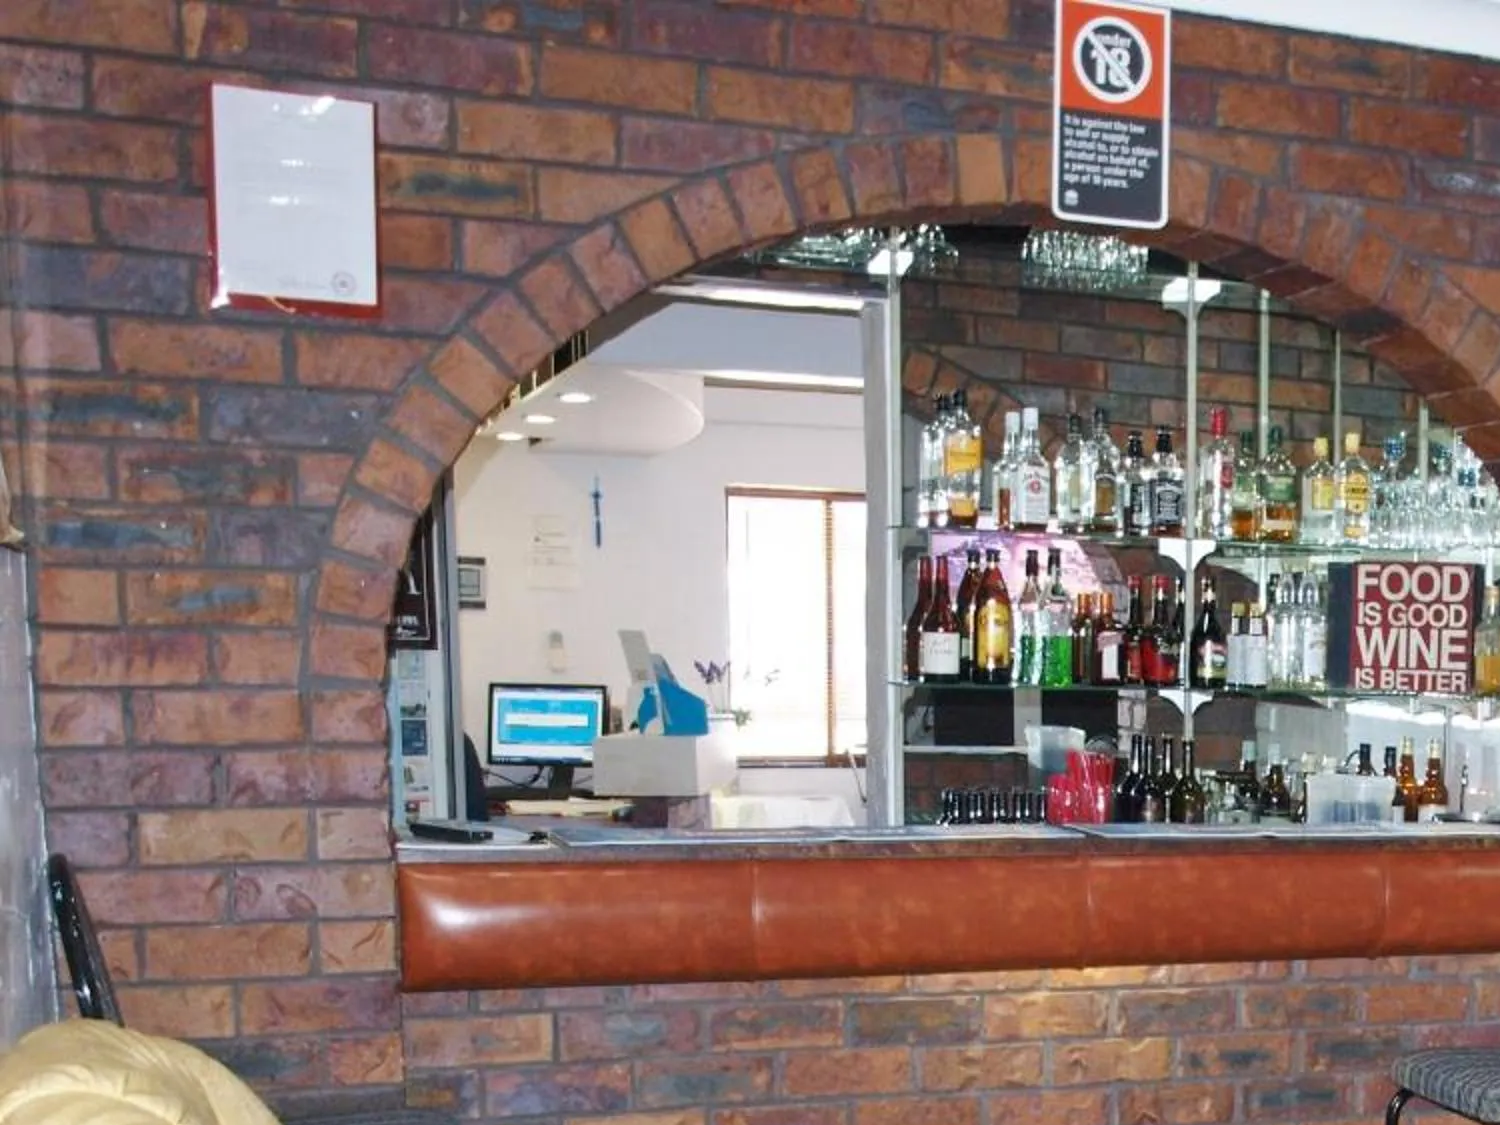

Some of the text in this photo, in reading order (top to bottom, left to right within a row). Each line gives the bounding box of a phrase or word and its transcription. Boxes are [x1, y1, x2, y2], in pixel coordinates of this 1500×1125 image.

[1090, 47, 1131, 88] 18
[1113, 120, 1128, 131] the
[1357, 564, 1470, 602] FOOD
[1358, 602, 1467, 628] IS GOOD
[1356, 626, 1468, 670] WINE
[1356, 668, 1467, 692] IS BETTER
